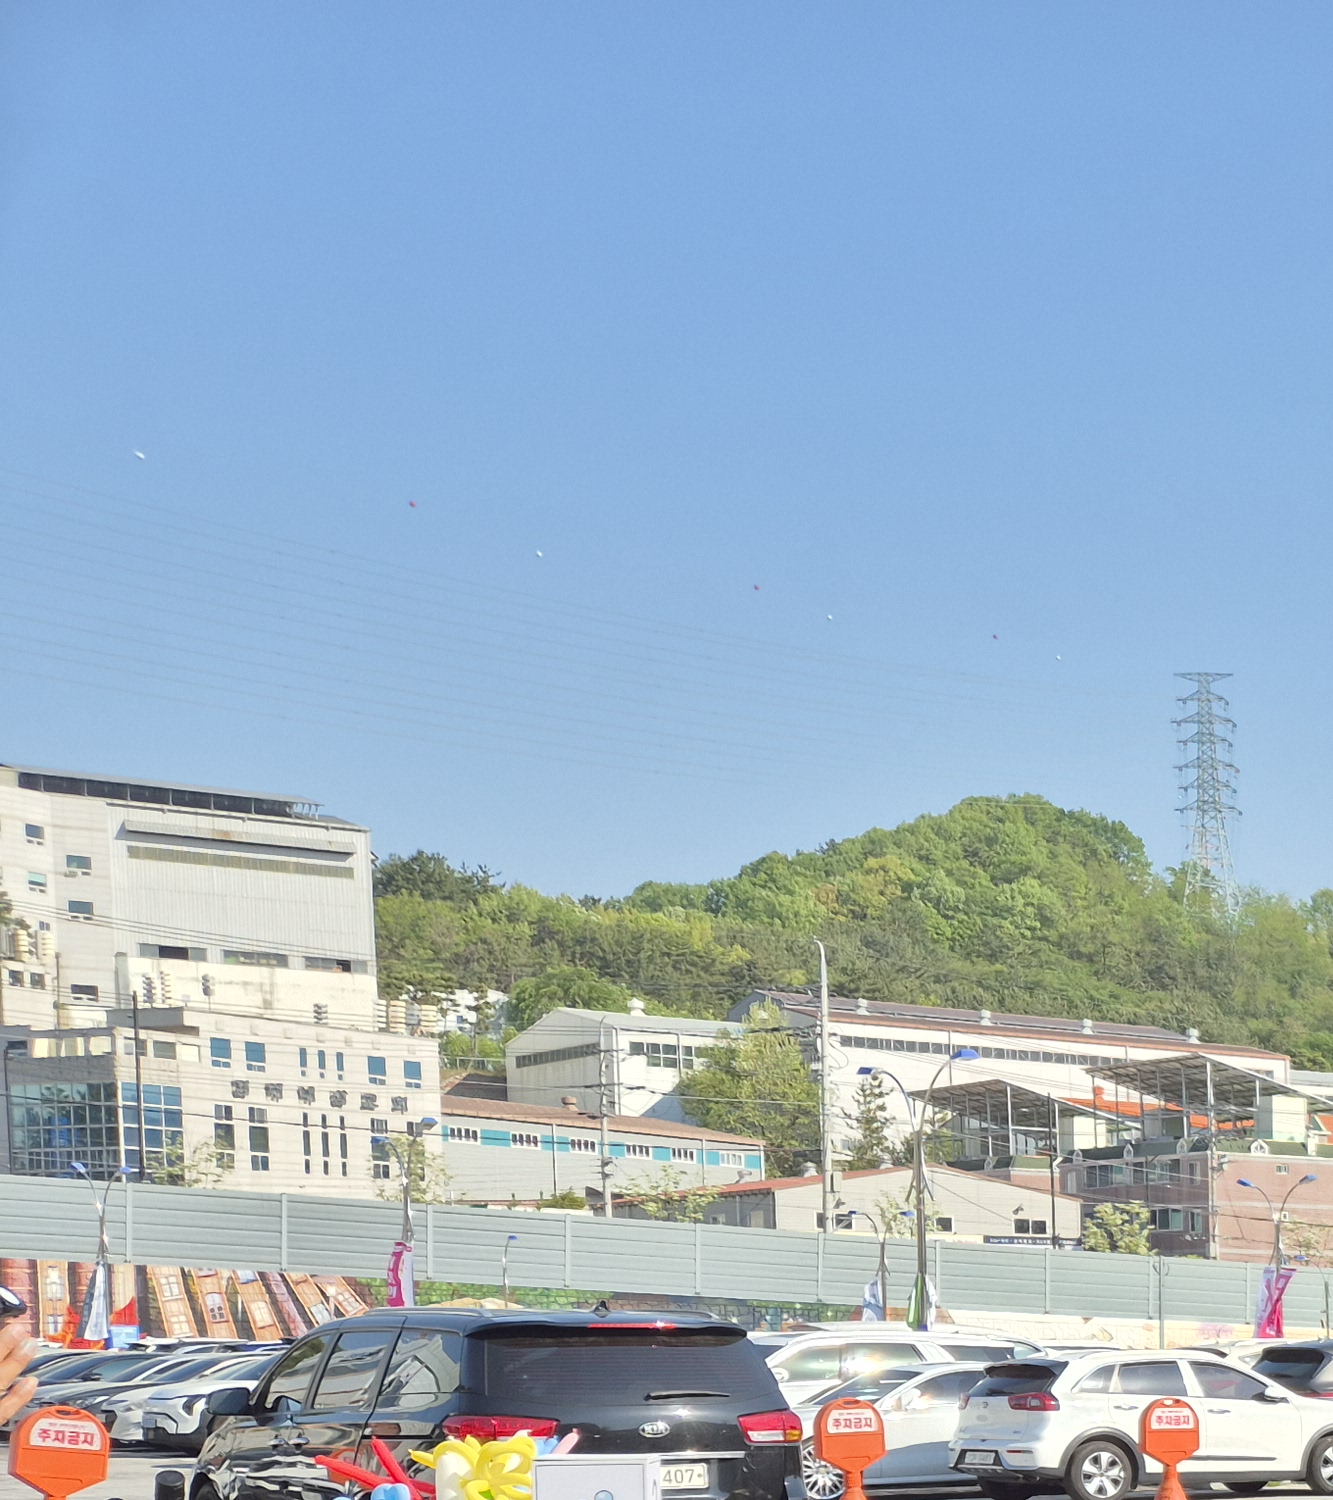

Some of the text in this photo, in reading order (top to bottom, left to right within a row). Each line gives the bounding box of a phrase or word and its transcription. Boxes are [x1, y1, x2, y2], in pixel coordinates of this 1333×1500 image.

[832, 1417, 873, 1430] 주차금지
[1155, 1415, 1190, 1426] 주차금지
[37, 1428, 95, 1447] 주차금지
